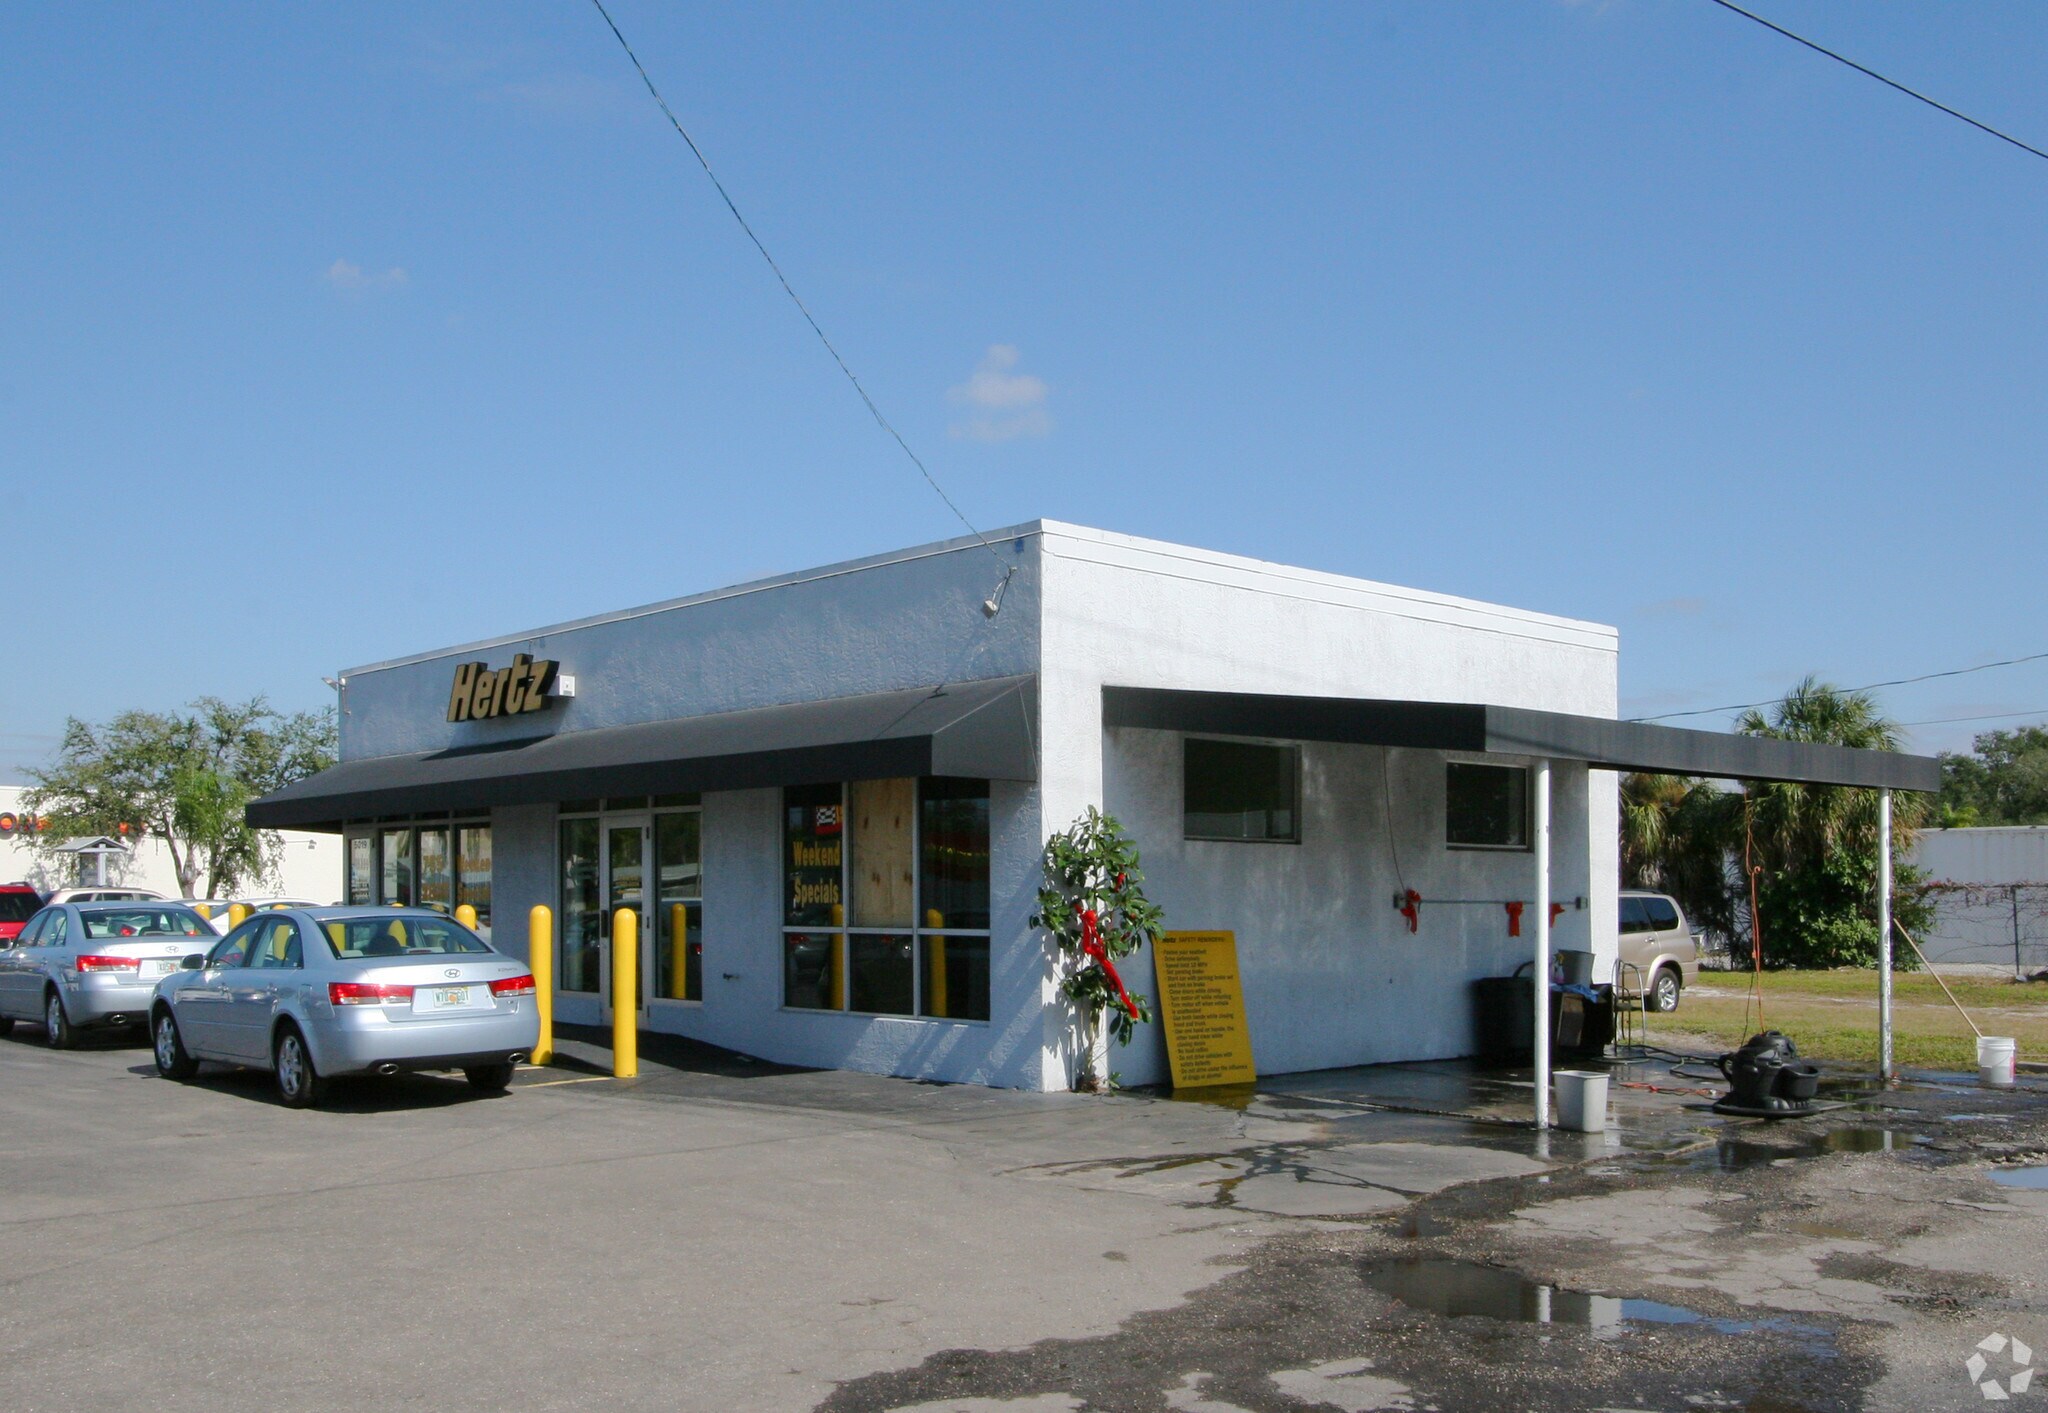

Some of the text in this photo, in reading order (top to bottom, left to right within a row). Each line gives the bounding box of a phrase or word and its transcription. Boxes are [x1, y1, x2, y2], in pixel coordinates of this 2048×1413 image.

[447, 653, 560, 722] Hertz
[793, 841, 840, 867] Weekend
[794, 877, 839, 906] Specials
